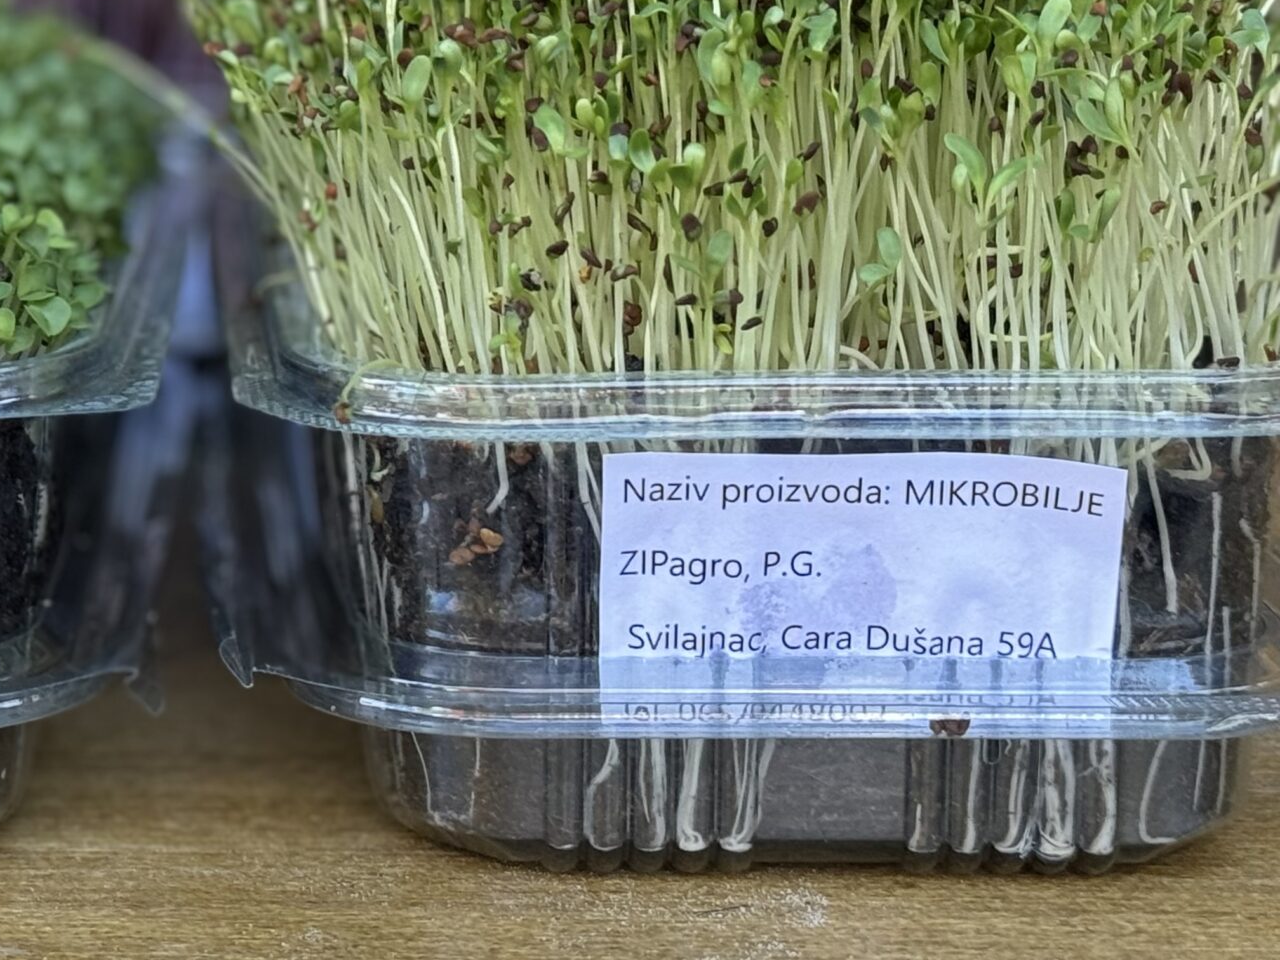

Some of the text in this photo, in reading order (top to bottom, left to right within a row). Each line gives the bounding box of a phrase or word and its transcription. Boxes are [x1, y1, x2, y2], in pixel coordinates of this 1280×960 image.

[623, 474, 1105, 517] Naziv proizvoda: MIKROBILJE
[619, 549, 822, 586] ZIPagro, P.G.
[627, 624, 1058, 661] Svilajnac, Cara Dušana 59A
